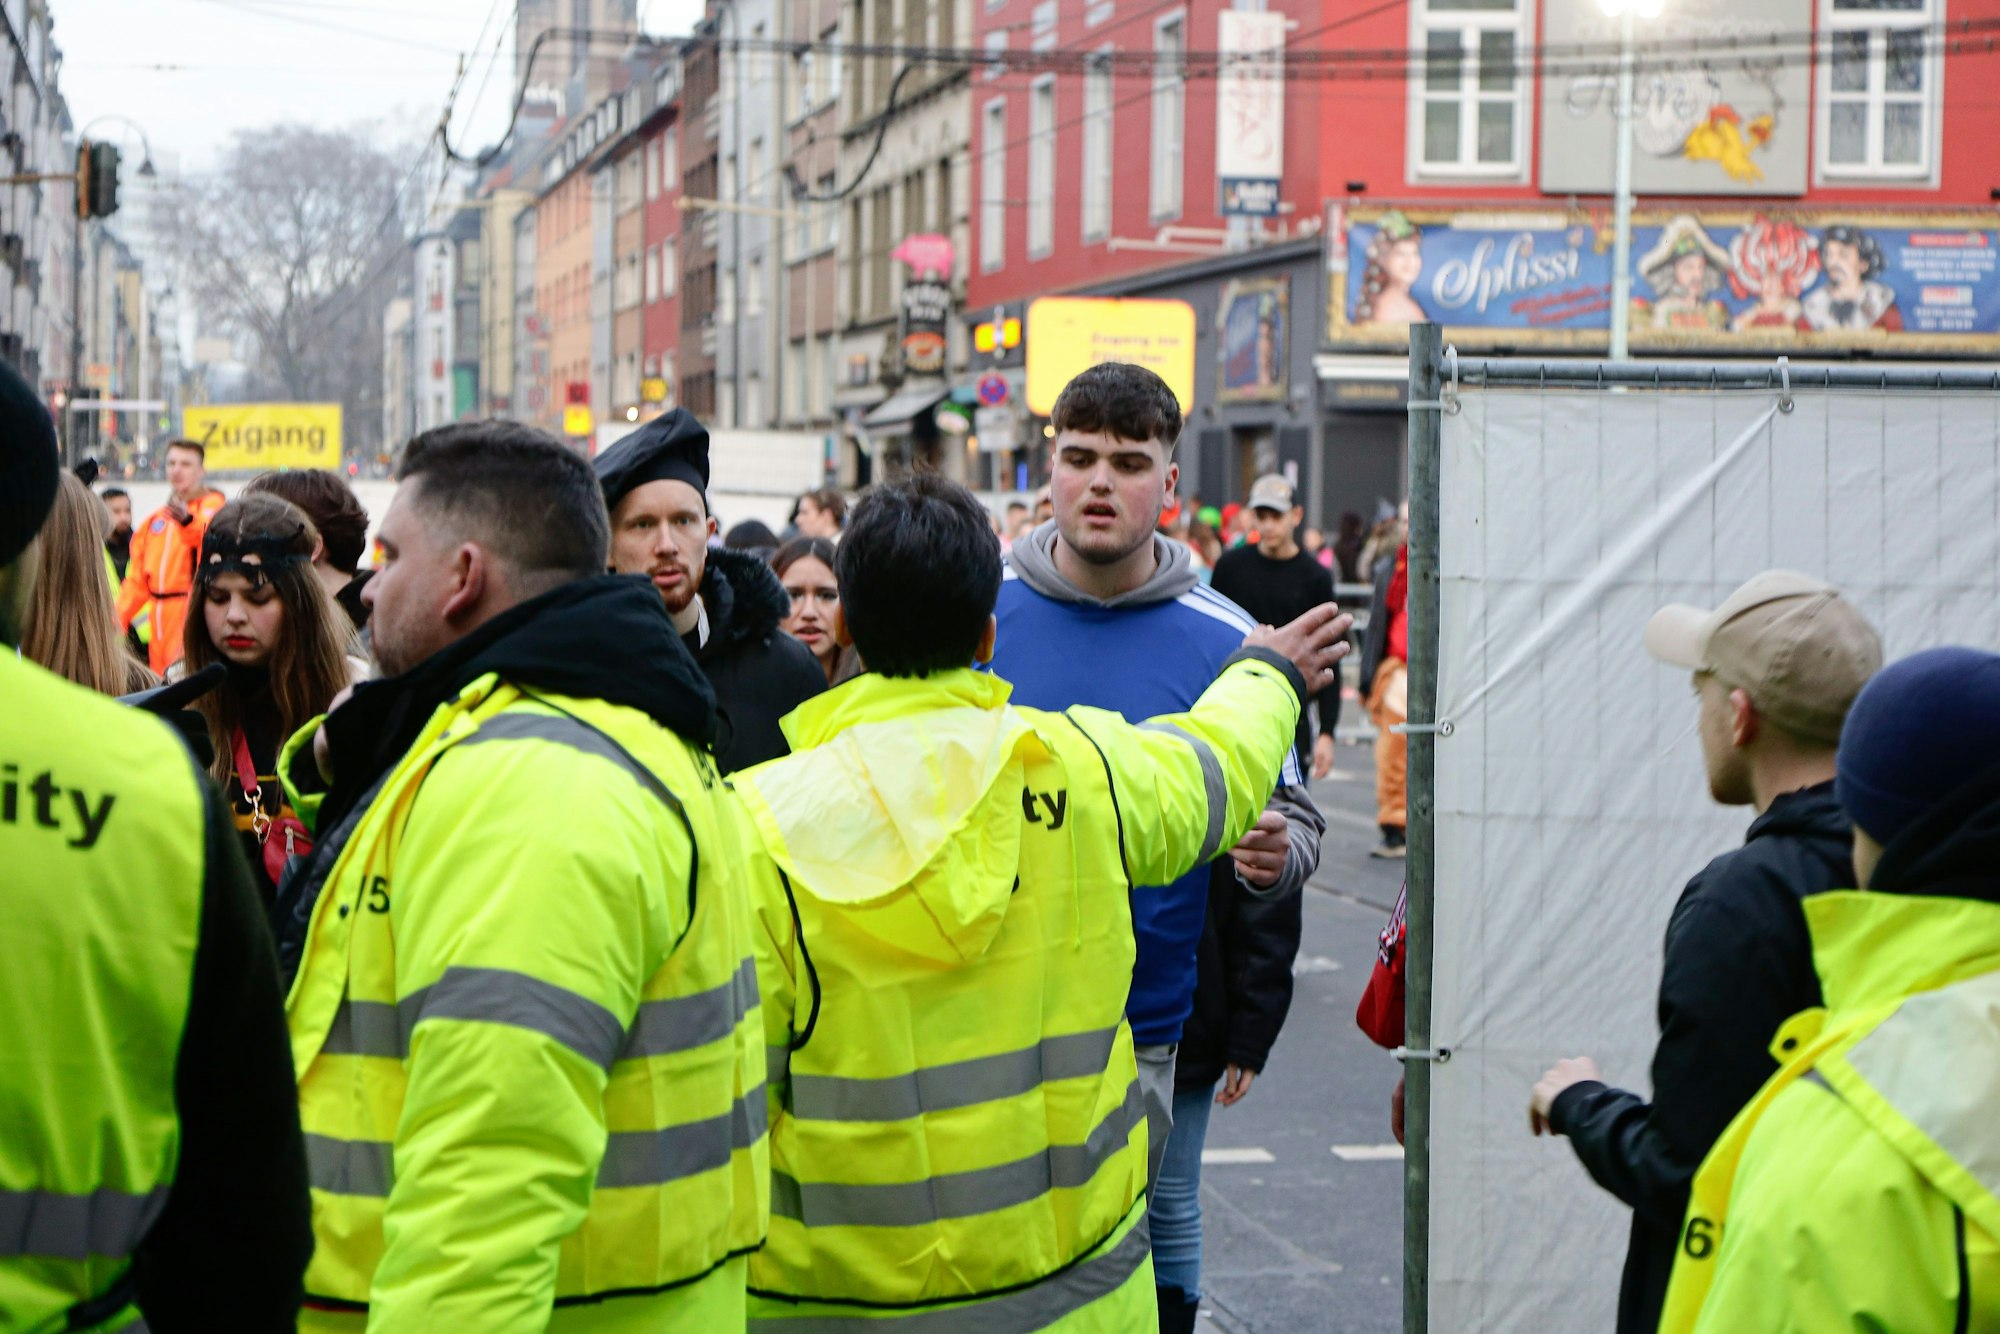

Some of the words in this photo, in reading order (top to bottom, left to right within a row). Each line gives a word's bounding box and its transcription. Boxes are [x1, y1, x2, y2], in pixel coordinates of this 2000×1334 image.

[1432, 229, 1582, 314] Splissi
[200, 420, 326, 455] Zugang
[2, 763, 116, 850] ity
[1022, 785, 1067, 831] ty
[355, 875, 390, 914] 5
